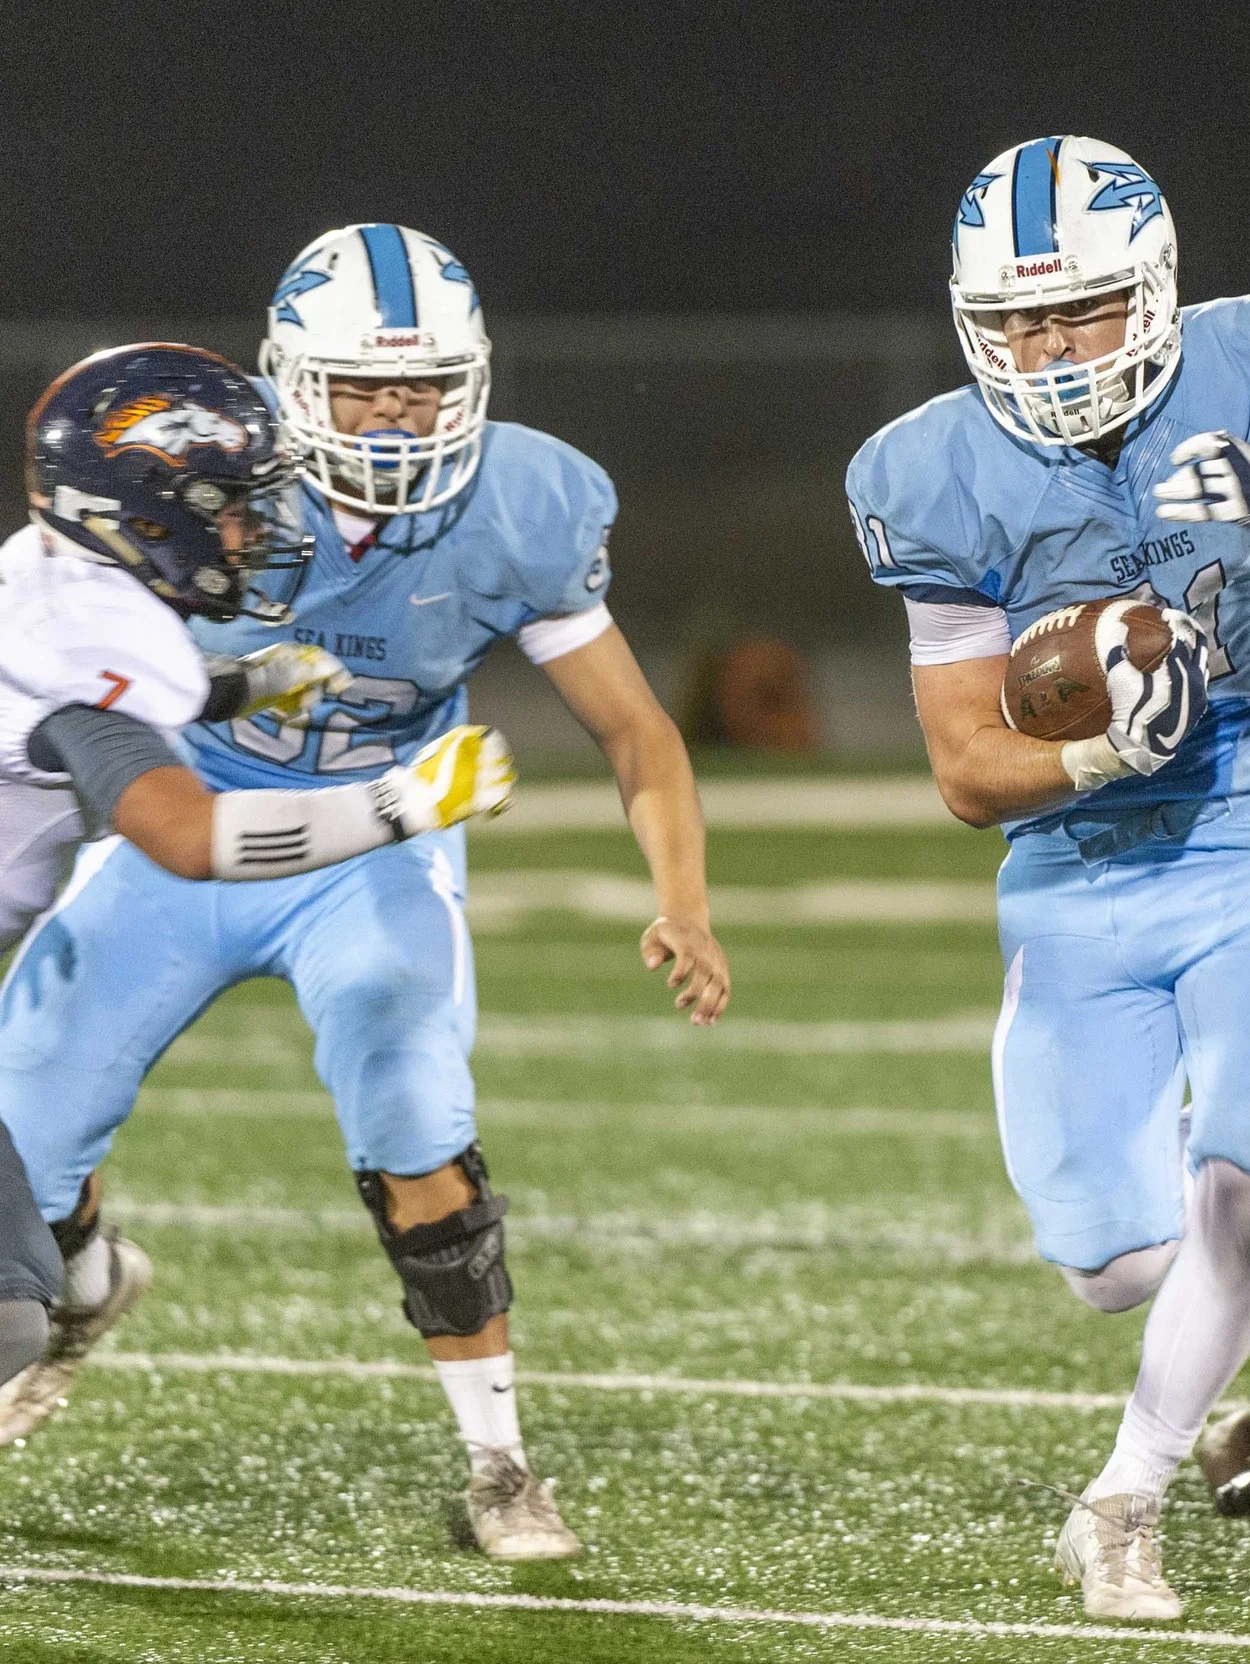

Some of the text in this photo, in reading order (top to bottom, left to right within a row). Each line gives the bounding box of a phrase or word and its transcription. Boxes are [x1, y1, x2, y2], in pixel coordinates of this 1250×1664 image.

[1016, 259, 1062, 278] Riddell
[1110, 529, 1196, 583] SEA KINGS
[97, 670, 133, 710] 7
